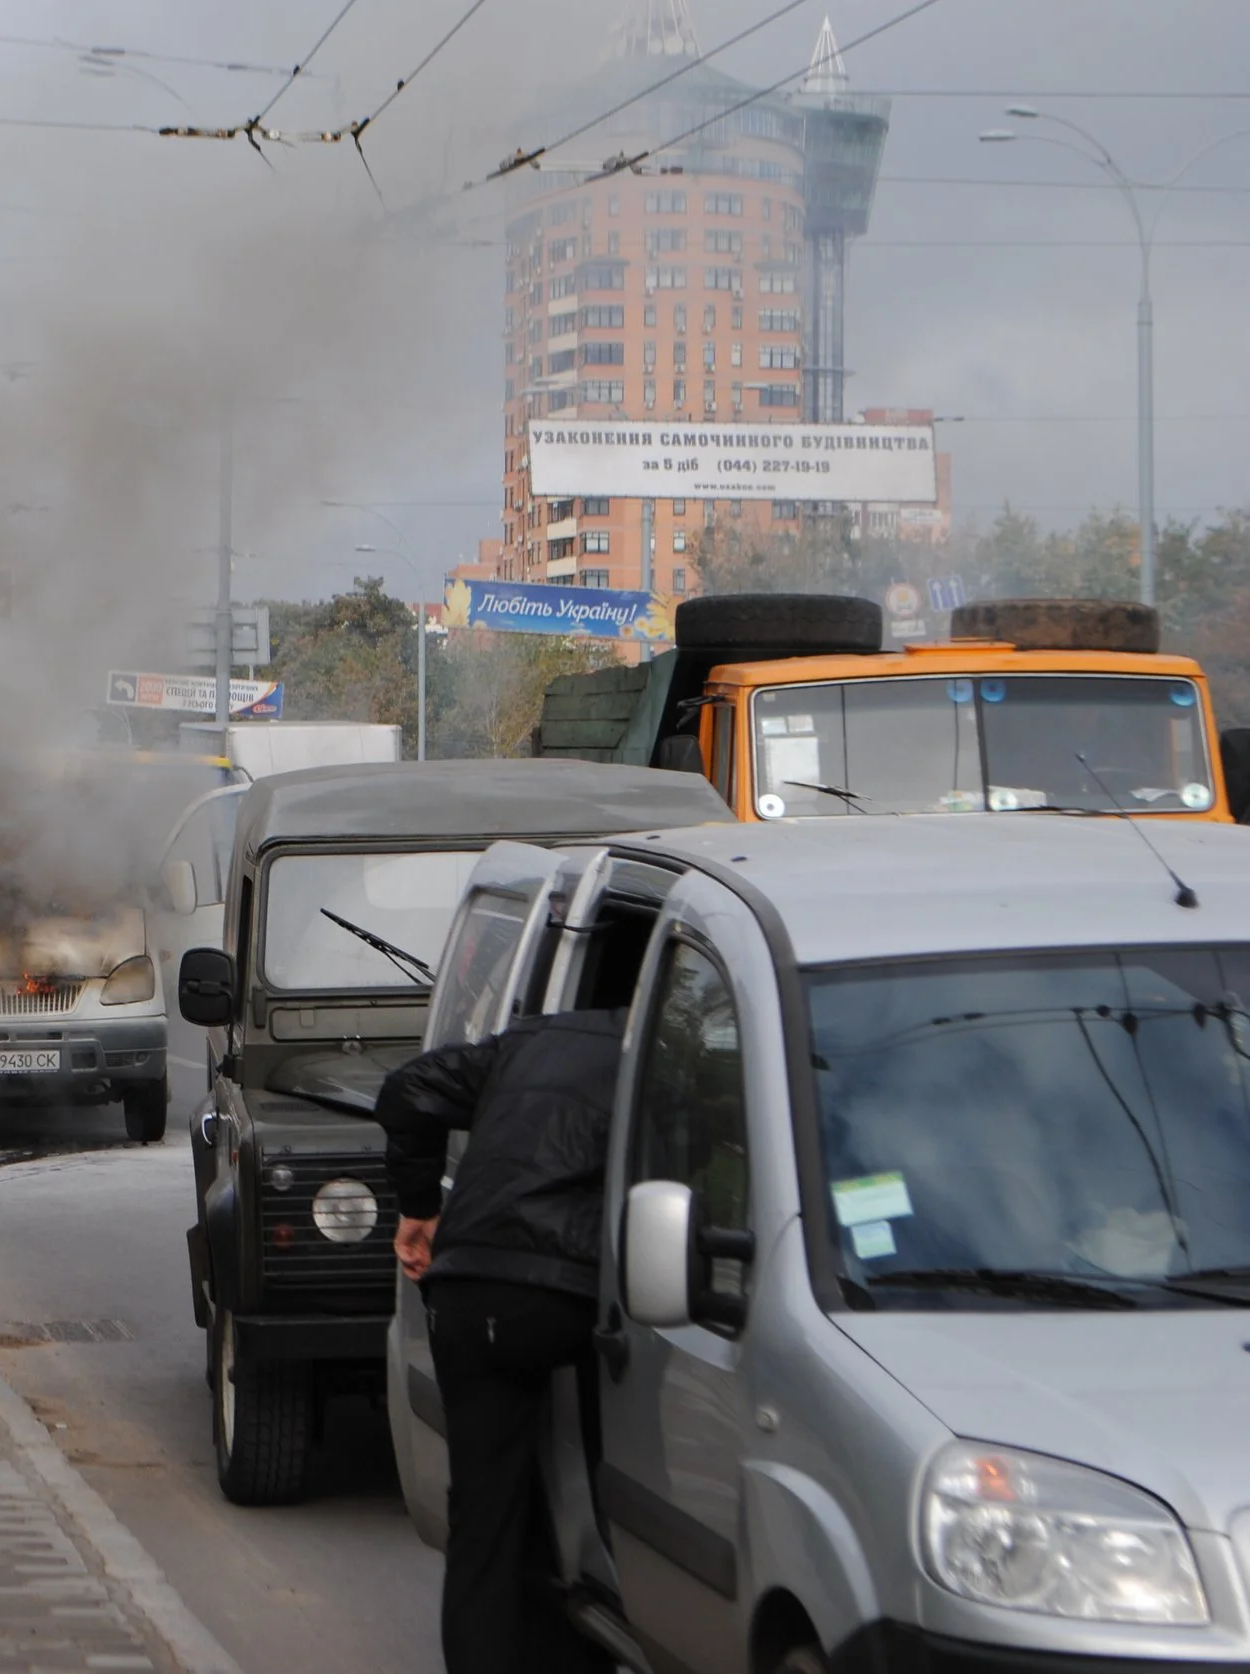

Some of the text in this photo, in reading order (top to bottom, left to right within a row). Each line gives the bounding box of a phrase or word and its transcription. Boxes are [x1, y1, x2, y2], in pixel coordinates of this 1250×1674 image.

[533, 430, 930, 452] УЗАКОНЕННЯ САМОЧИННОГО БУДІВНИЦТВА
[642, 460, 659, 471] за
[677, 457, 699, 473] діб
[717, 459, 757, 474] (044)
[762, 460, 831, 474] 227-19-19
[477, 594, 638, 625] Любіть Україну!
[0, 1054, 33, 1069] 9430
[36, 1053, 56, 1068] CK
